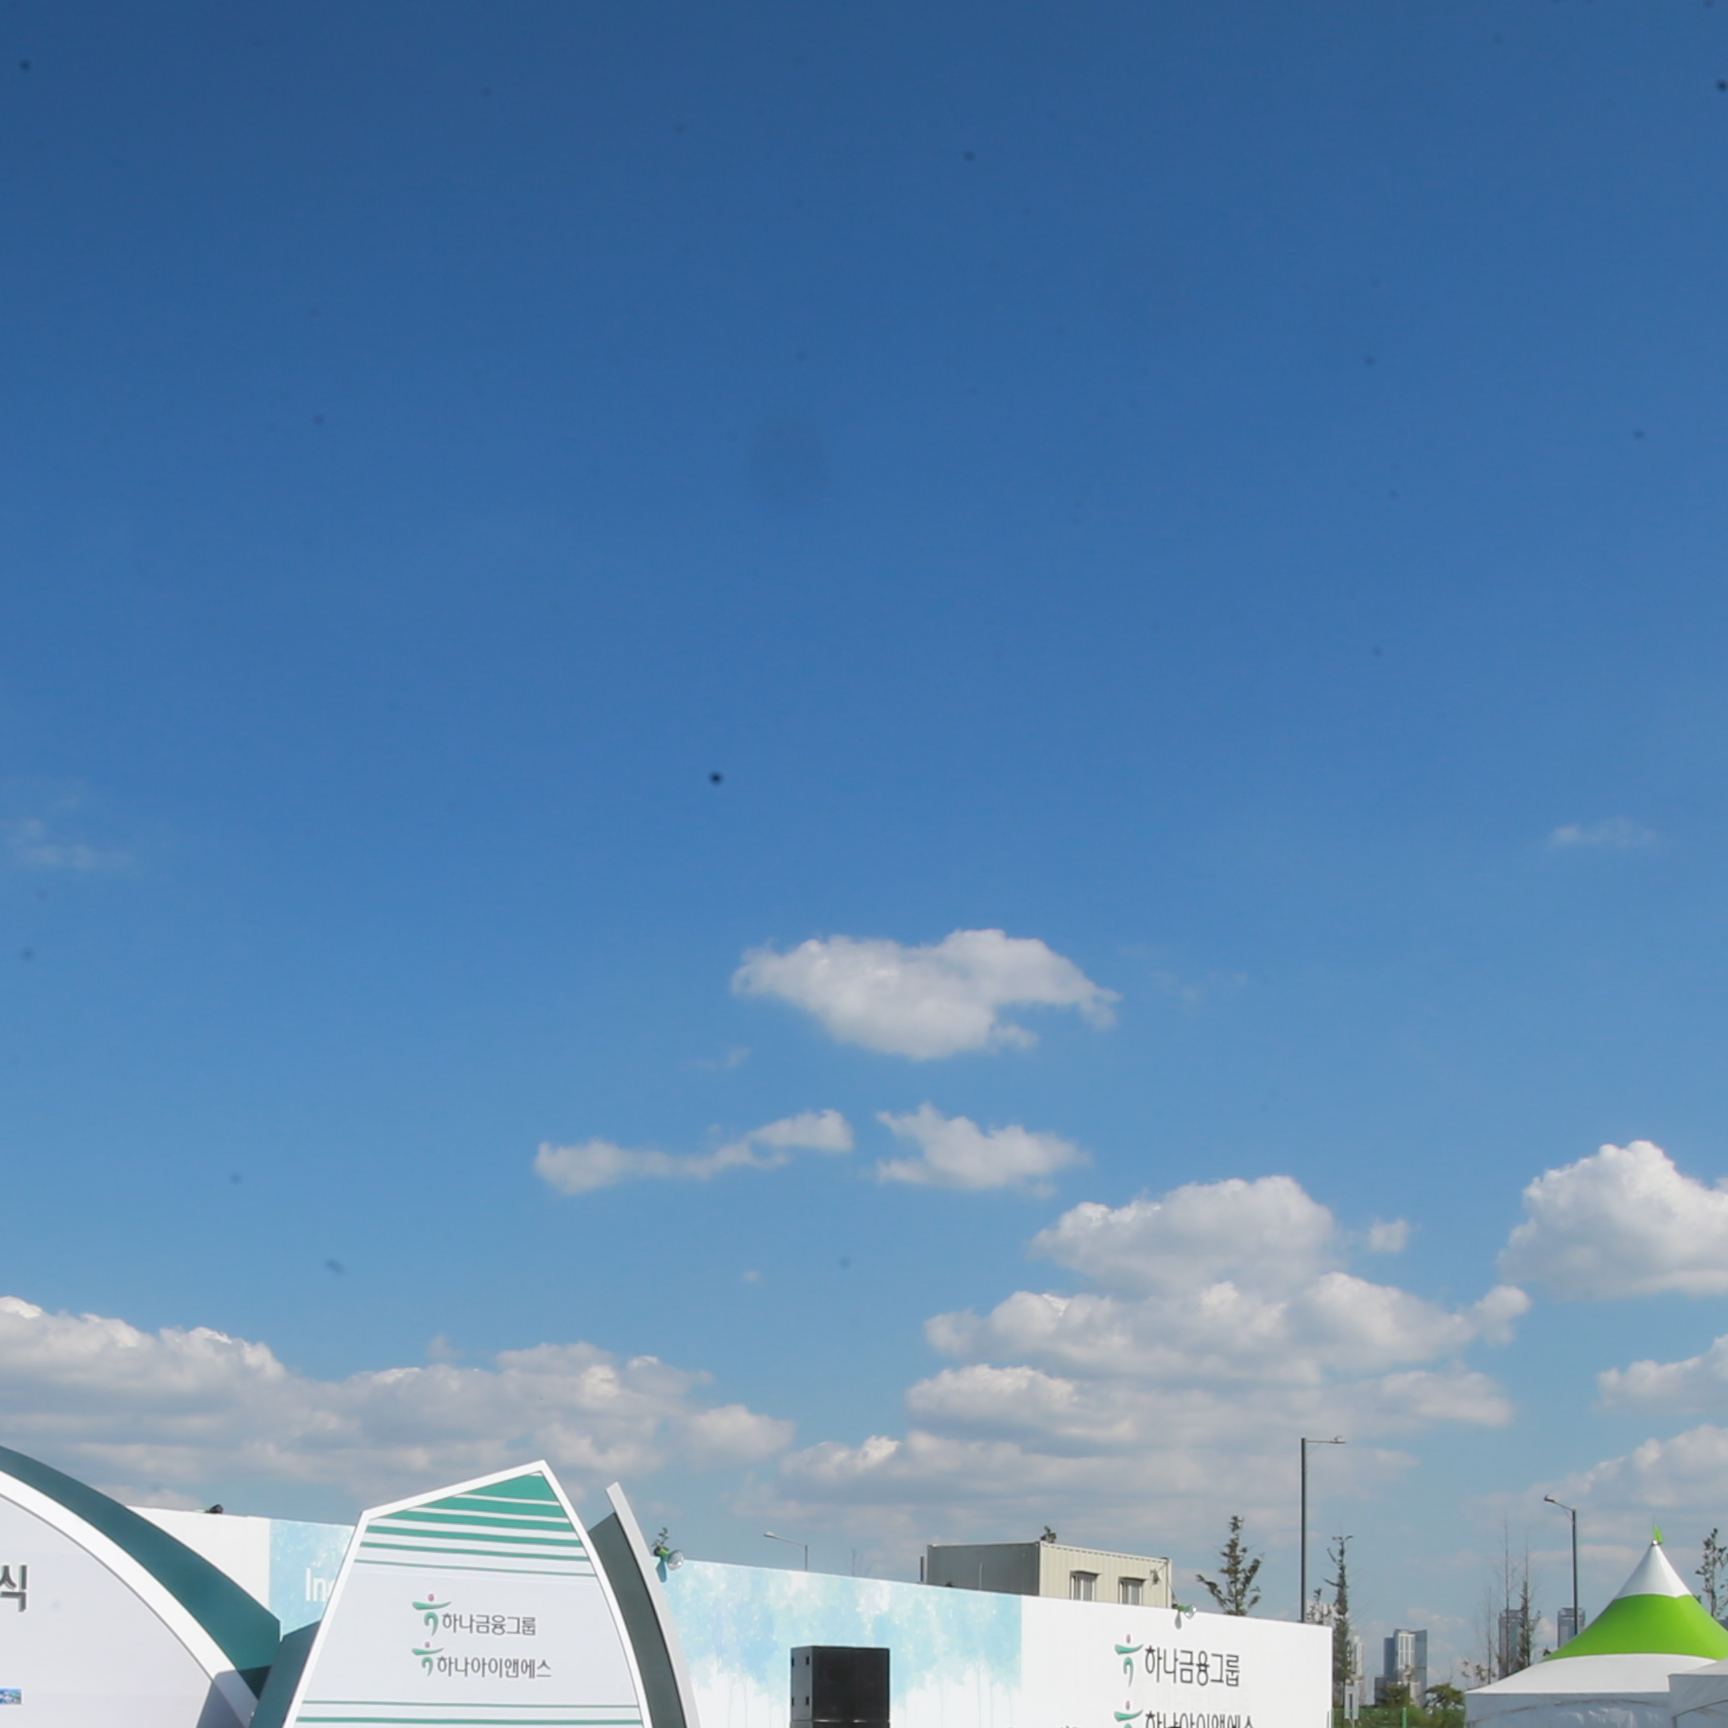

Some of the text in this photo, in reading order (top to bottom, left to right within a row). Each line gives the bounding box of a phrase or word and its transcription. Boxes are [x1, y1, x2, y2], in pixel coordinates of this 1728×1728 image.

[442, 1612, 537, 1637] 하나금융그룹
[437, 1656, 552, 1679] 하나아이앤에스
[1145, 1645, 1240, 1687] 하나금융그룹
